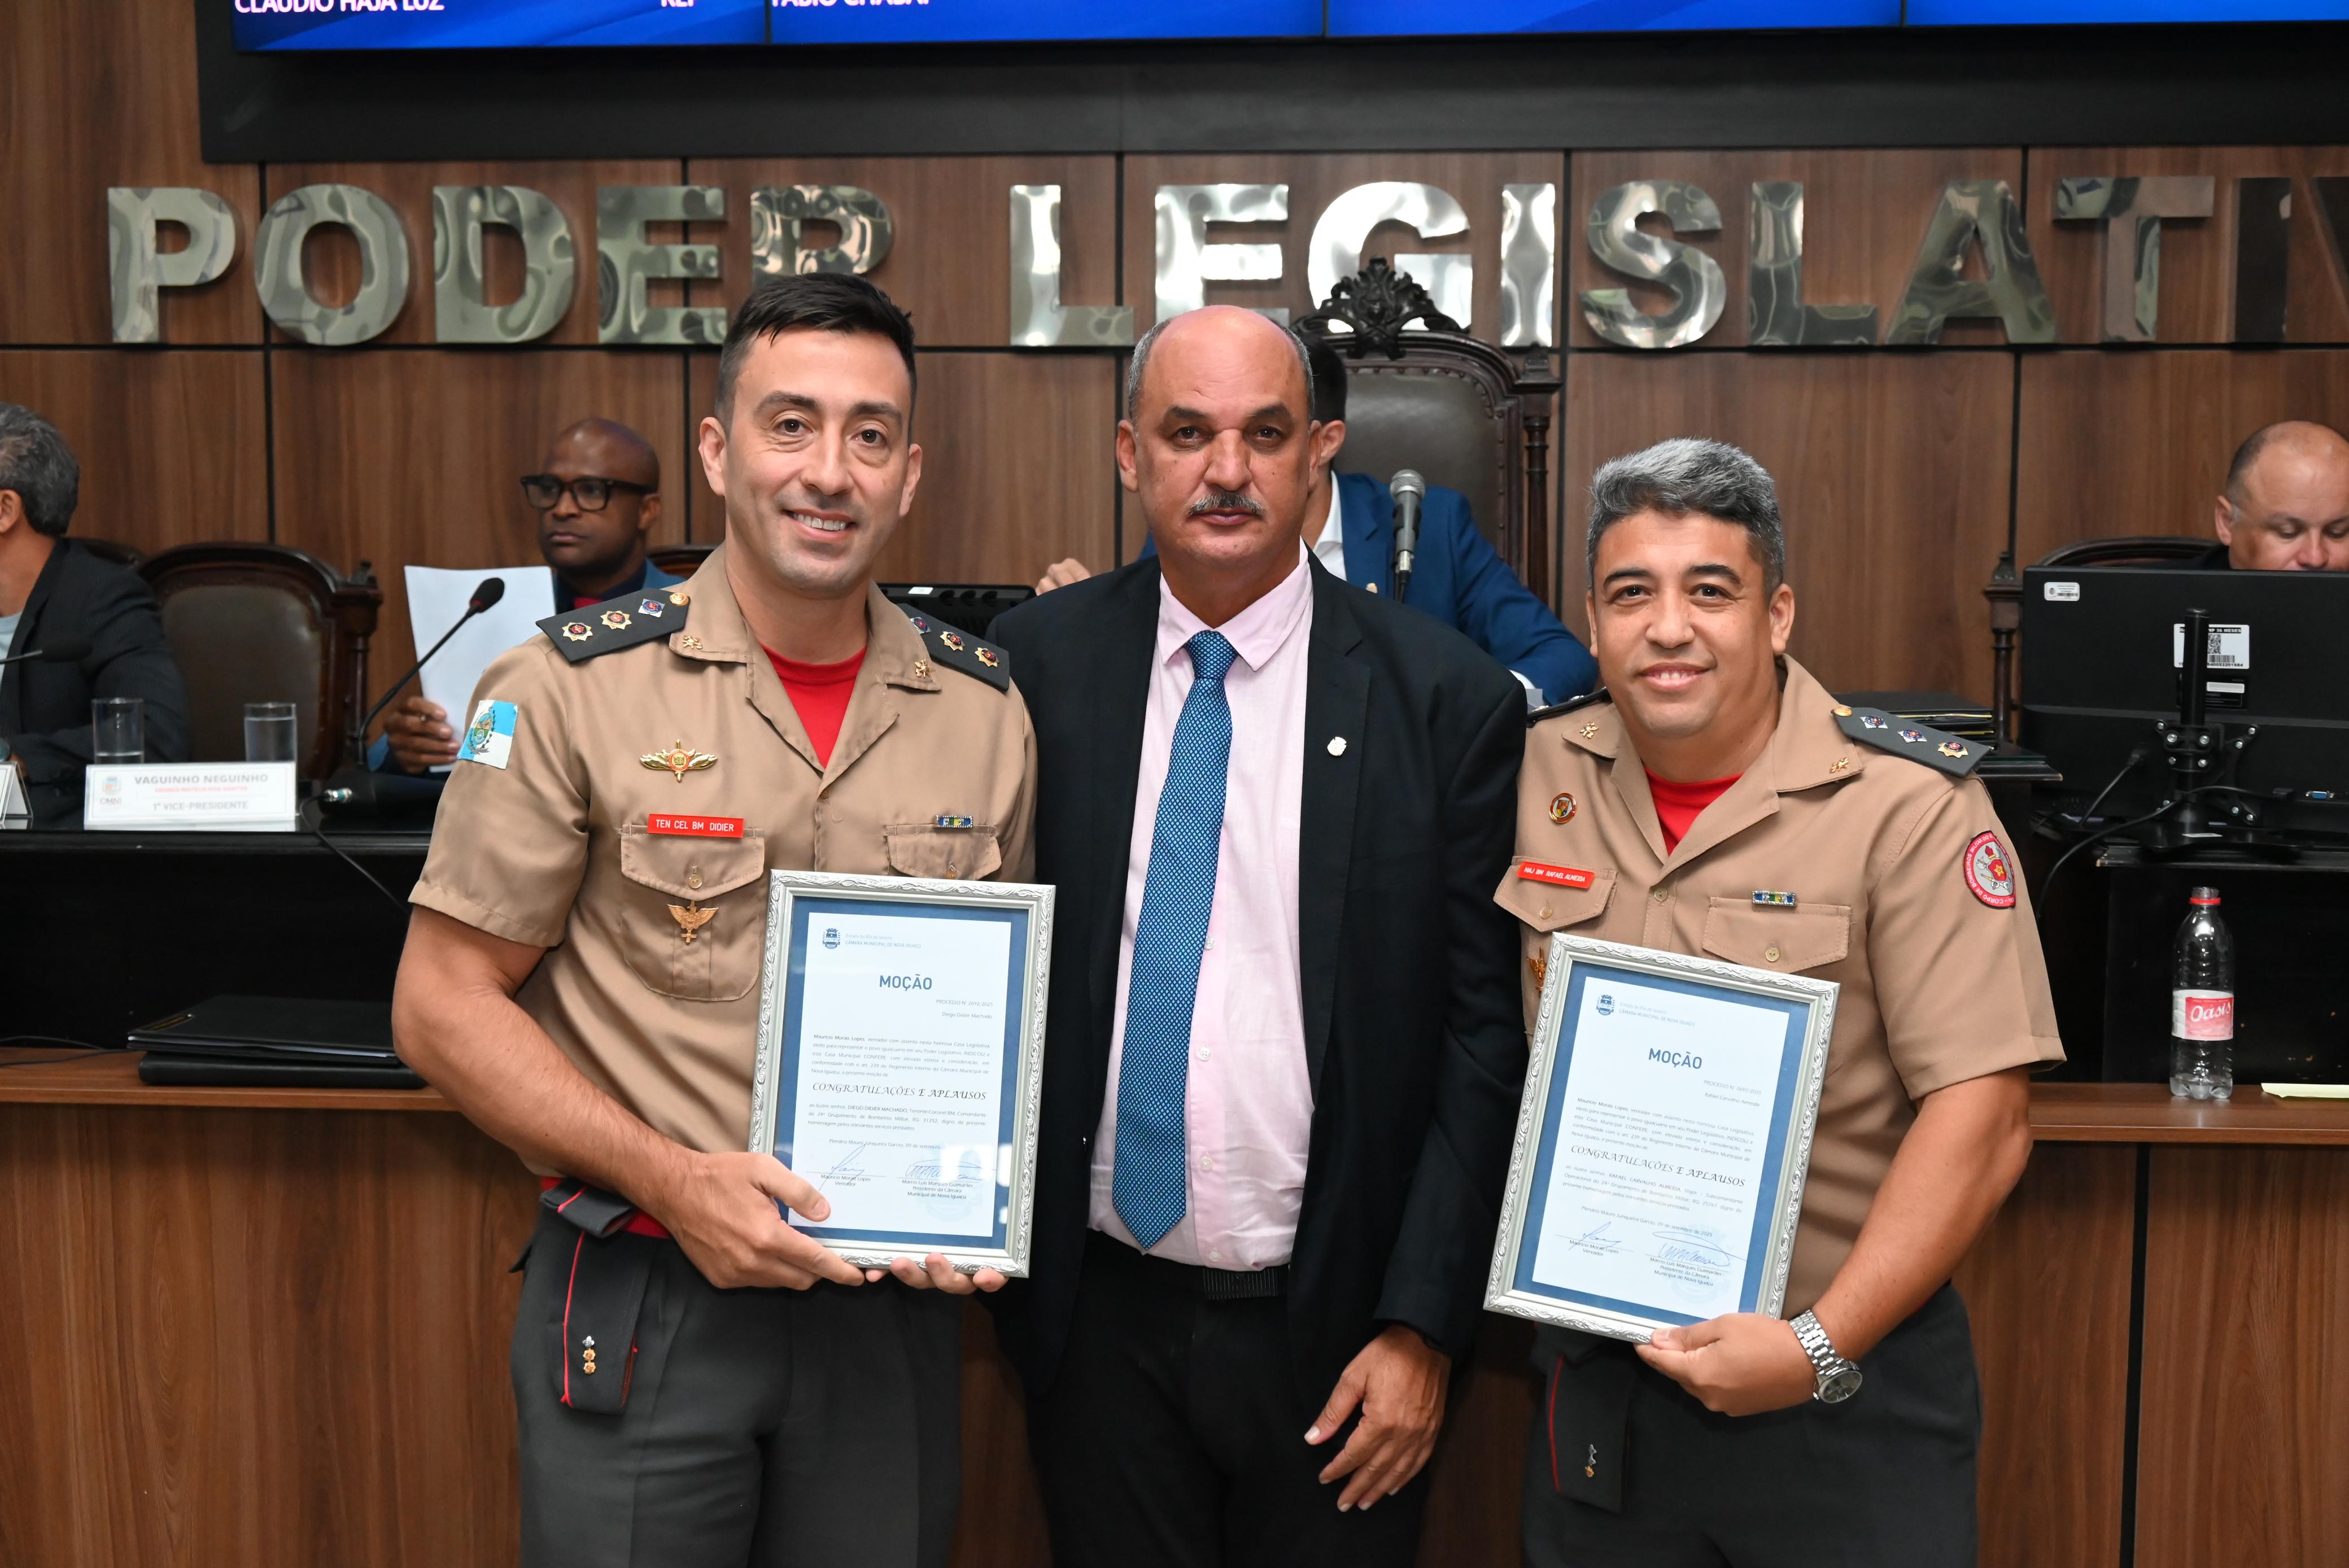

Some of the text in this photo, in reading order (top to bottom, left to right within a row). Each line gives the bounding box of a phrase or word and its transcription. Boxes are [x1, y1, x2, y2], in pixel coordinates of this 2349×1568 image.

[108, 184, 893, 346] PODER
[135, 774, 268, 784] VAGUINHO NEGUINHO
[163, 801, 248, 810] VICE-PRESIDENTE
[656, 819, 734, 832] TEN CEL BM DIDIER
[1970, 838, 1983, 853] MILITAR
[1545, 871, 1564, 879] RAFAEL
[1966, 853, 1977, 888] BOMBEIROS
[1983, 894, 2004, 903] CORPO
[879, 973, 932, 991] MOÇÃO
[1648, 1047, 1702, 1069] MOÇÃO
[813, 1082, 915, 1097] CONGRATULAÇÕES
[927, 1089, 986, 1099] APLAUSOS
[1571, 1145, 1674, 1173] CONGRATULAÇÕES
[1685, 1169, 1745, 1187] APLAUSOS
